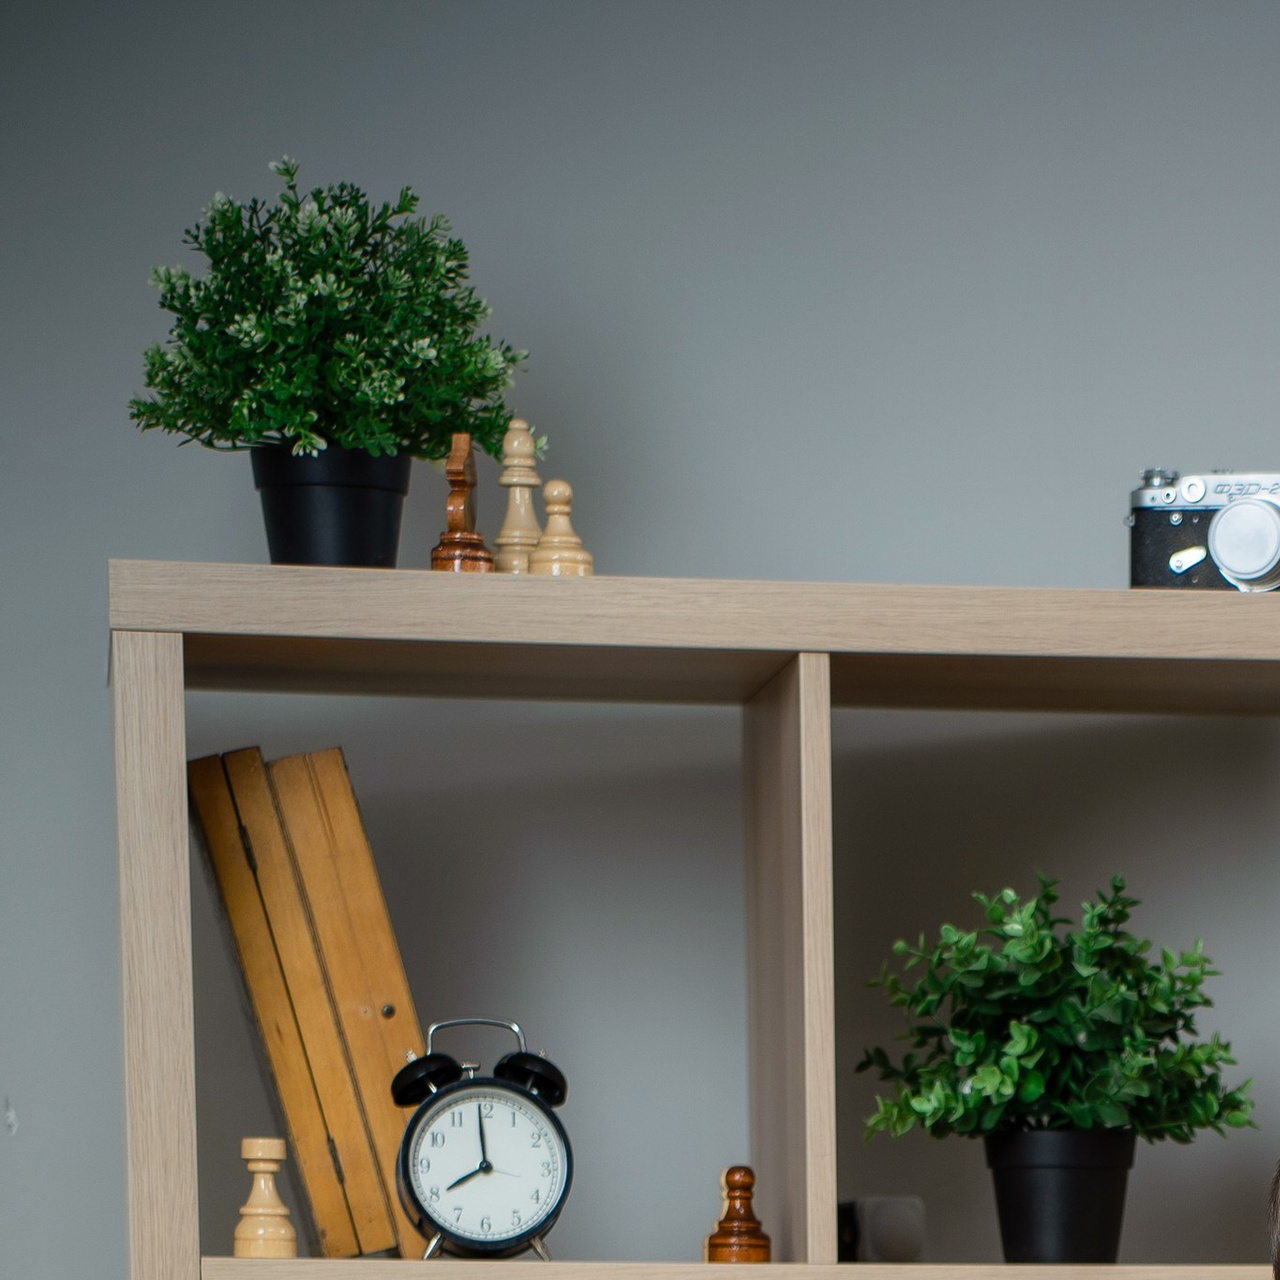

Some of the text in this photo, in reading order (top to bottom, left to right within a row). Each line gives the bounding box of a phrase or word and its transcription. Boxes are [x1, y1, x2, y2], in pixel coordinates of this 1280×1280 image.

[451, 1111, 463, 1127] 11
[478, 1103, 494, 1119] 2
[510, 1112, 516, 1127] 1
[431, 1131, 445, 1148] 10
[531, 1132, 542, 1148] 2
[420, 1158, 431, 1174] 9
[541, 1161, 551, 1177] 3
[430, 1186, 441, 1203] 8
[530, 1189, 540, 1204] 4
[453, 1207, 463, 1224] 7
[511, 1209, 521, 1226] 5
[480, 1217, 491, 1233] 6
